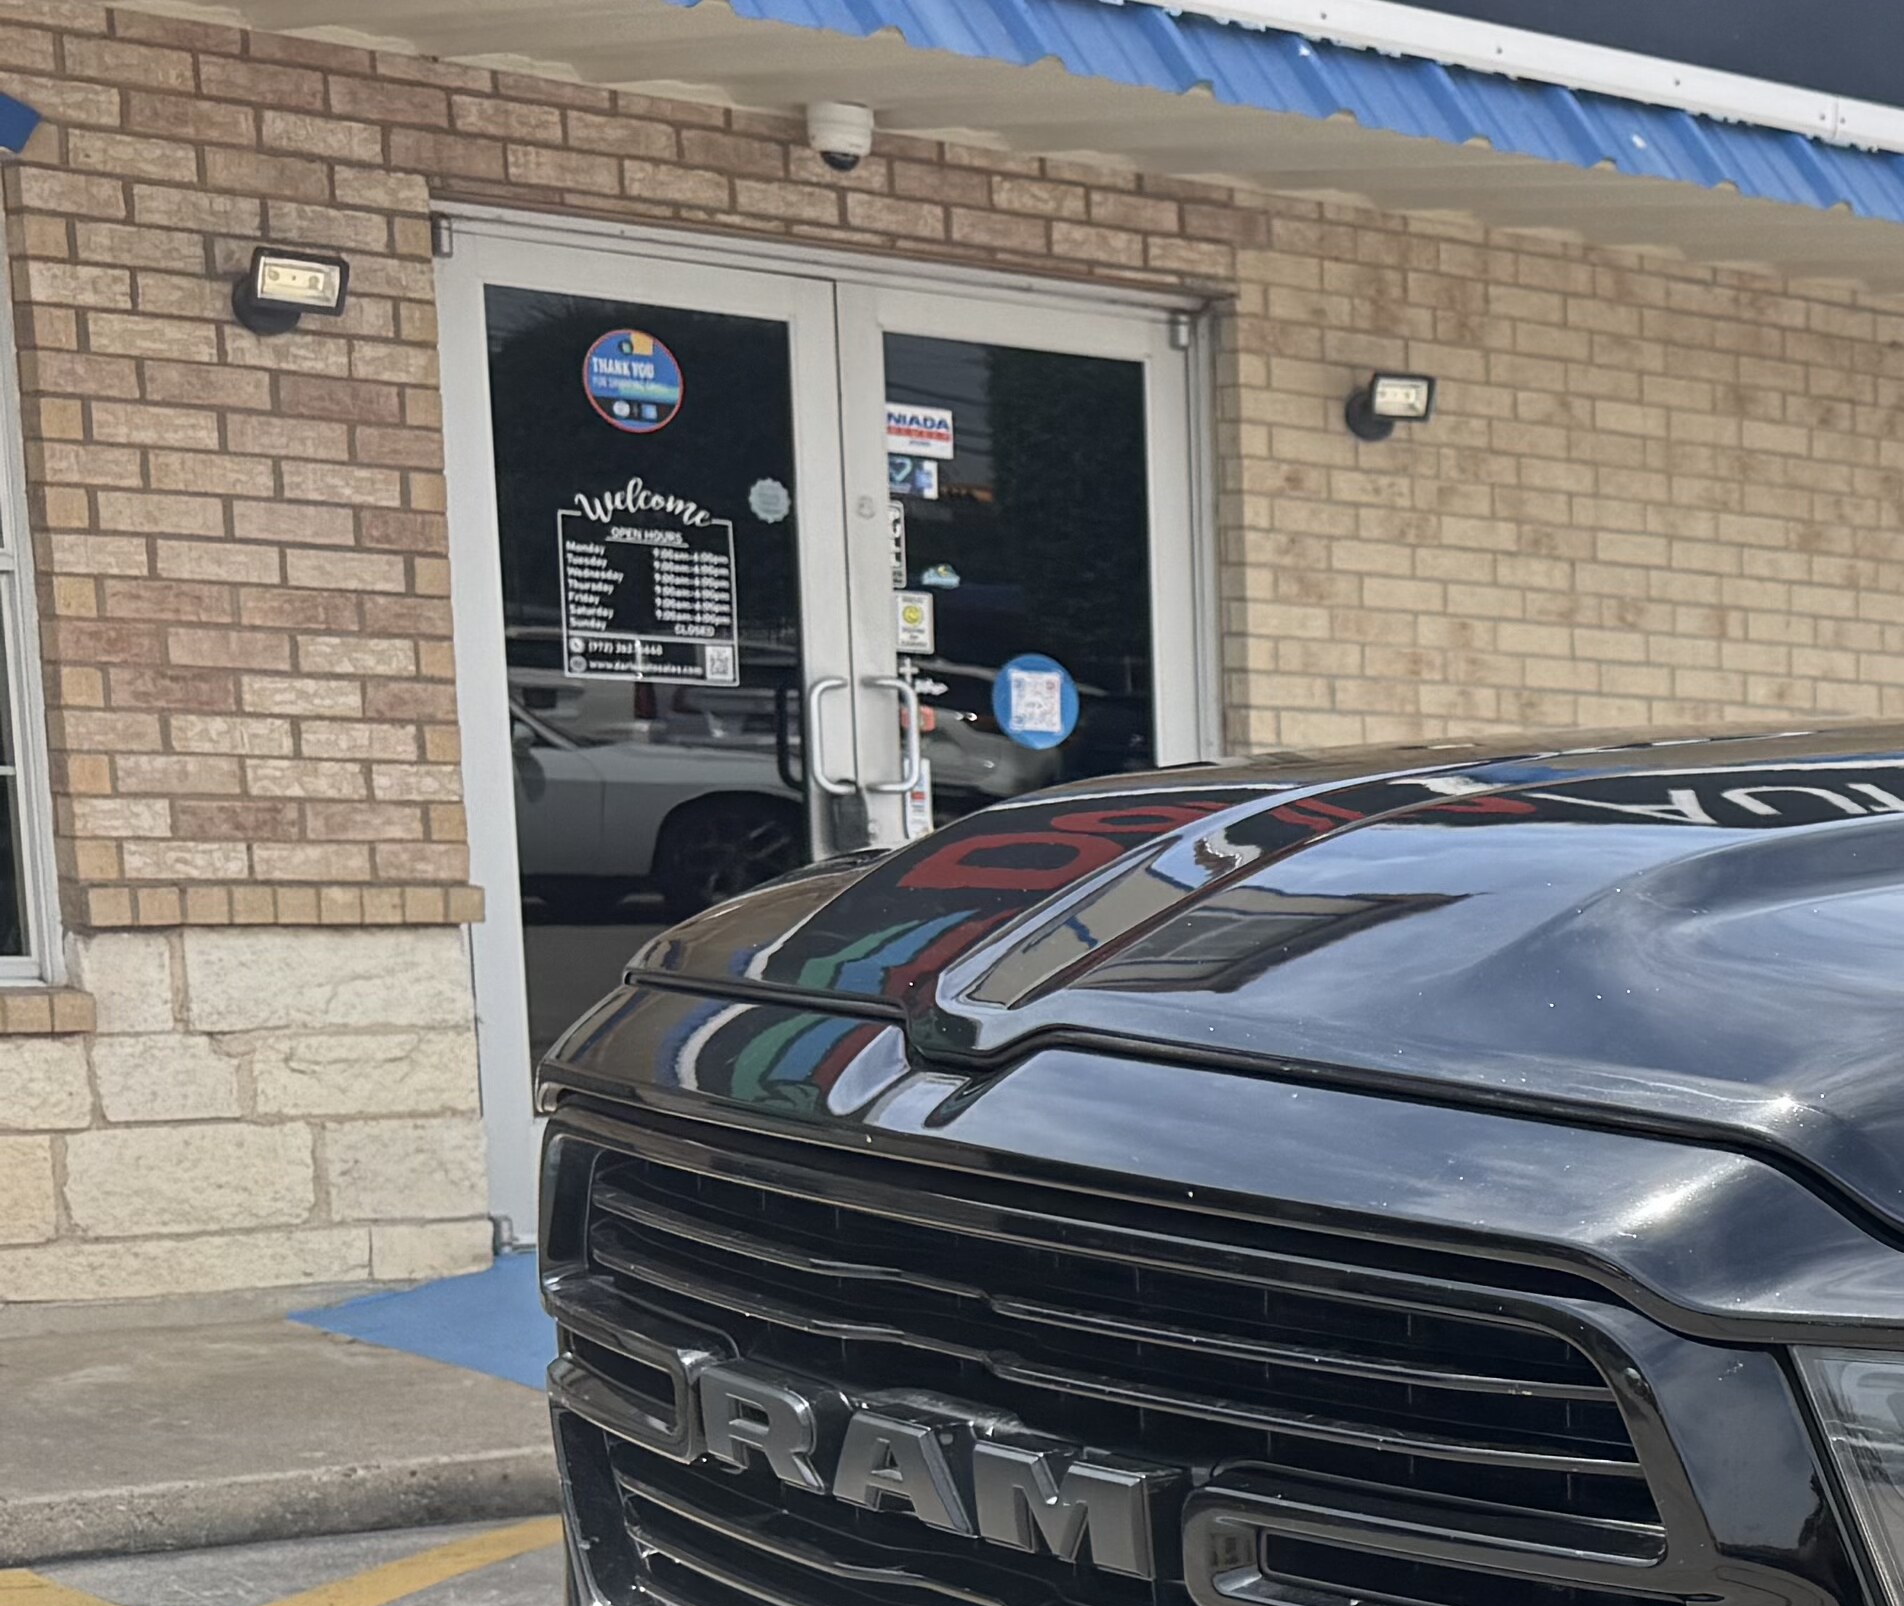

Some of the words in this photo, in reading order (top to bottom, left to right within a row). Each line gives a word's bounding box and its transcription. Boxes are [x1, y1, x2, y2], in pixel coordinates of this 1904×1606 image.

[592, 356, 630, 377] THANK
[631, 361, 655, 379] YOU
[886, 412, 950, 430] NIADA
[574, 476, 712, 527] Welcome
[698, 1357, 1165, 1581] RAM
